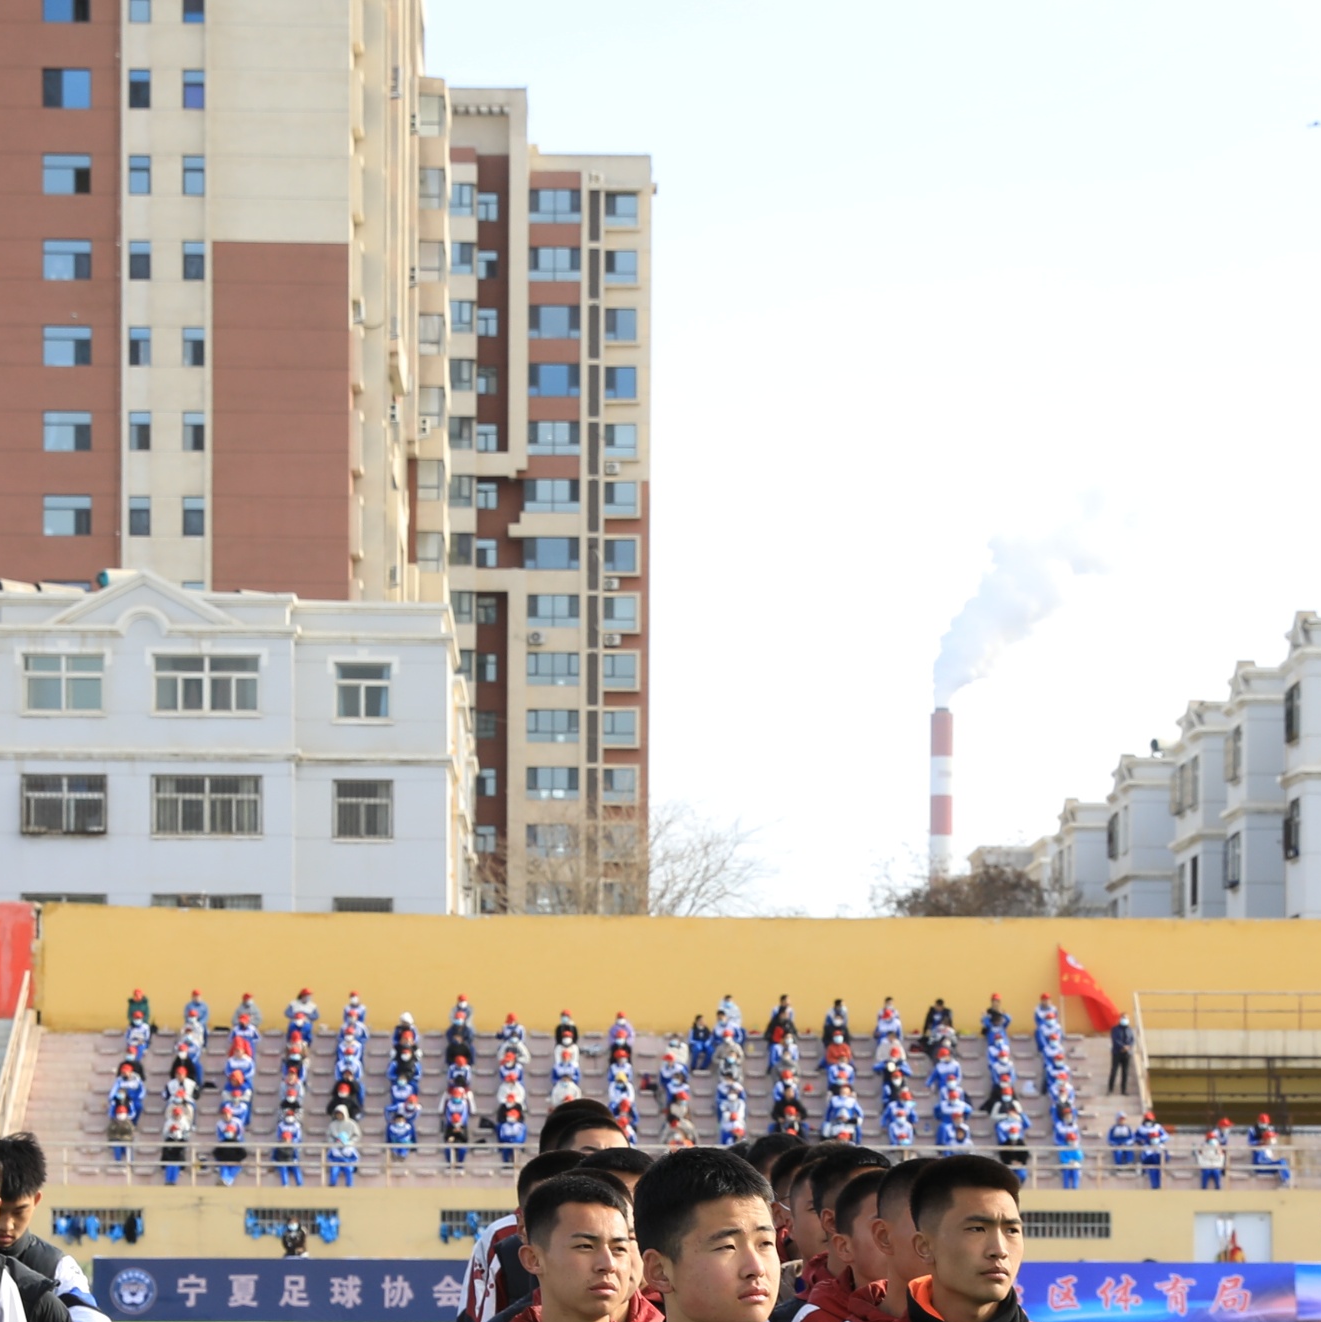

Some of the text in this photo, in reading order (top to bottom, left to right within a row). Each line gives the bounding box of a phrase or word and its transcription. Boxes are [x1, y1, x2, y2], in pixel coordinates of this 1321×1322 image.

[176, 1274, 463, 1309] 宁夏足球协会
[1014, 1274, 1253, 1316] 区体育局
